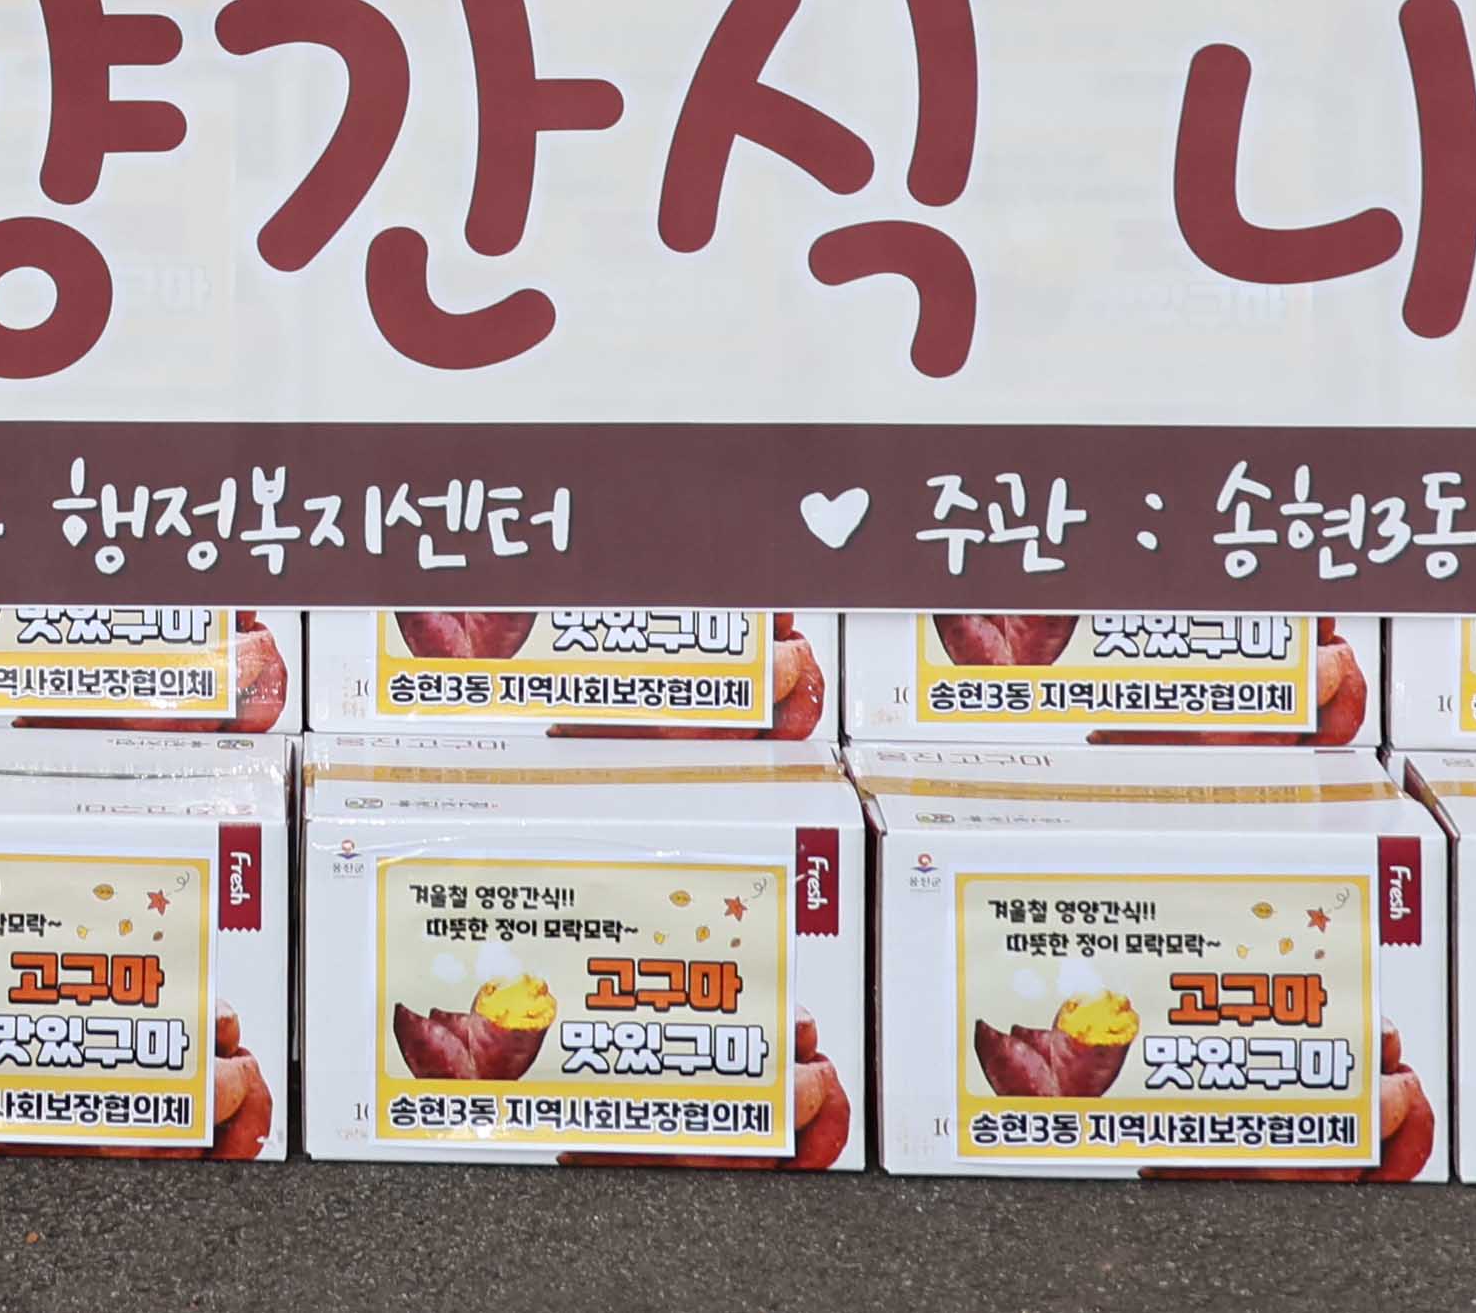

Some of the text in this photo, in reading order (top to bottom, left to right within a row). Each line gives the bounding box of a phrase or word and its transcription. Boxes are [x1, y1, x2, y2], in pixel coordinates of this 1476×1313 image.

[52, 457, 570, 575] 행정복지센터
[915, 473, 1087, 575] 주관
[1136, 493, 1163, 550] :
[389, 673, 749, 707] 송현3동 지역사회보장협의체
[928, 681, 1292, 711] 송현3동 지역사회보장협의체
[229, 851, 252, 906] Fresh
[1389, 865, 1412, 920] Fresh
[987, 898, 1156, 925] 겨울철 영양간식!!
[1004, 931, 1221, 957] 따뜻한 정이 모락모락~
[8, 951, 165, 1008] 고구마
[585, 957, 742, 1014] 고구마
[1168, 971, 1326, 1027] 고구마
[559, 1022, 768, 1077] 맛있구마
[1142, 1036, 1352, 1090] 맛있구마
[389, 1095, 771, 1132] 송현3동 지역사회보장협의체
[971, 1113, 1356, 1145] 송현3동 지역사회보장협의체
